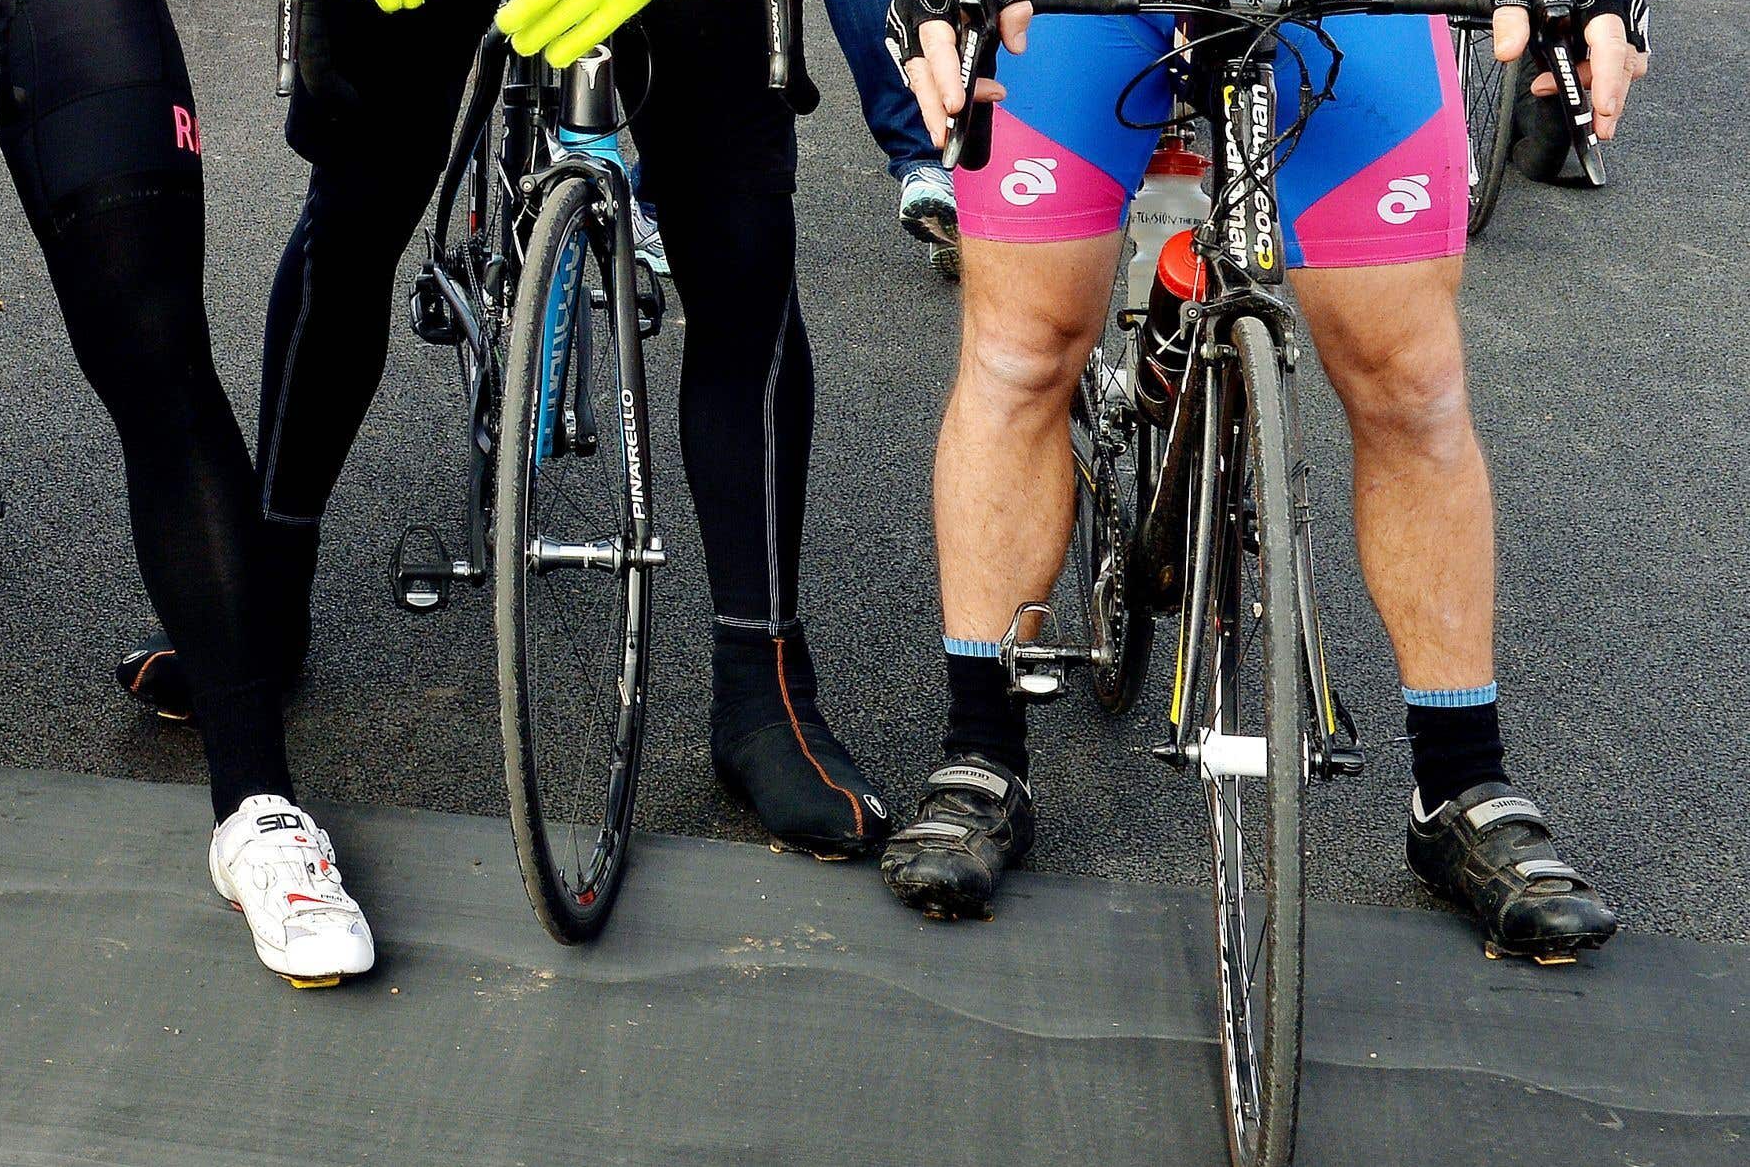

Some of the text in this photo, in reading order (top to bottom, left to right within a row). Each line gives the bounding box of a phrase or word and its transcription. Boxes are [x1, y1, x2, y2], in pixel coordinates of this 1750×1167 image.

[1553, 46, 1582, 108] SRAM
[621, 389, 645, 520] PINARELLO
[256, 813, 306, 834] SIDI
